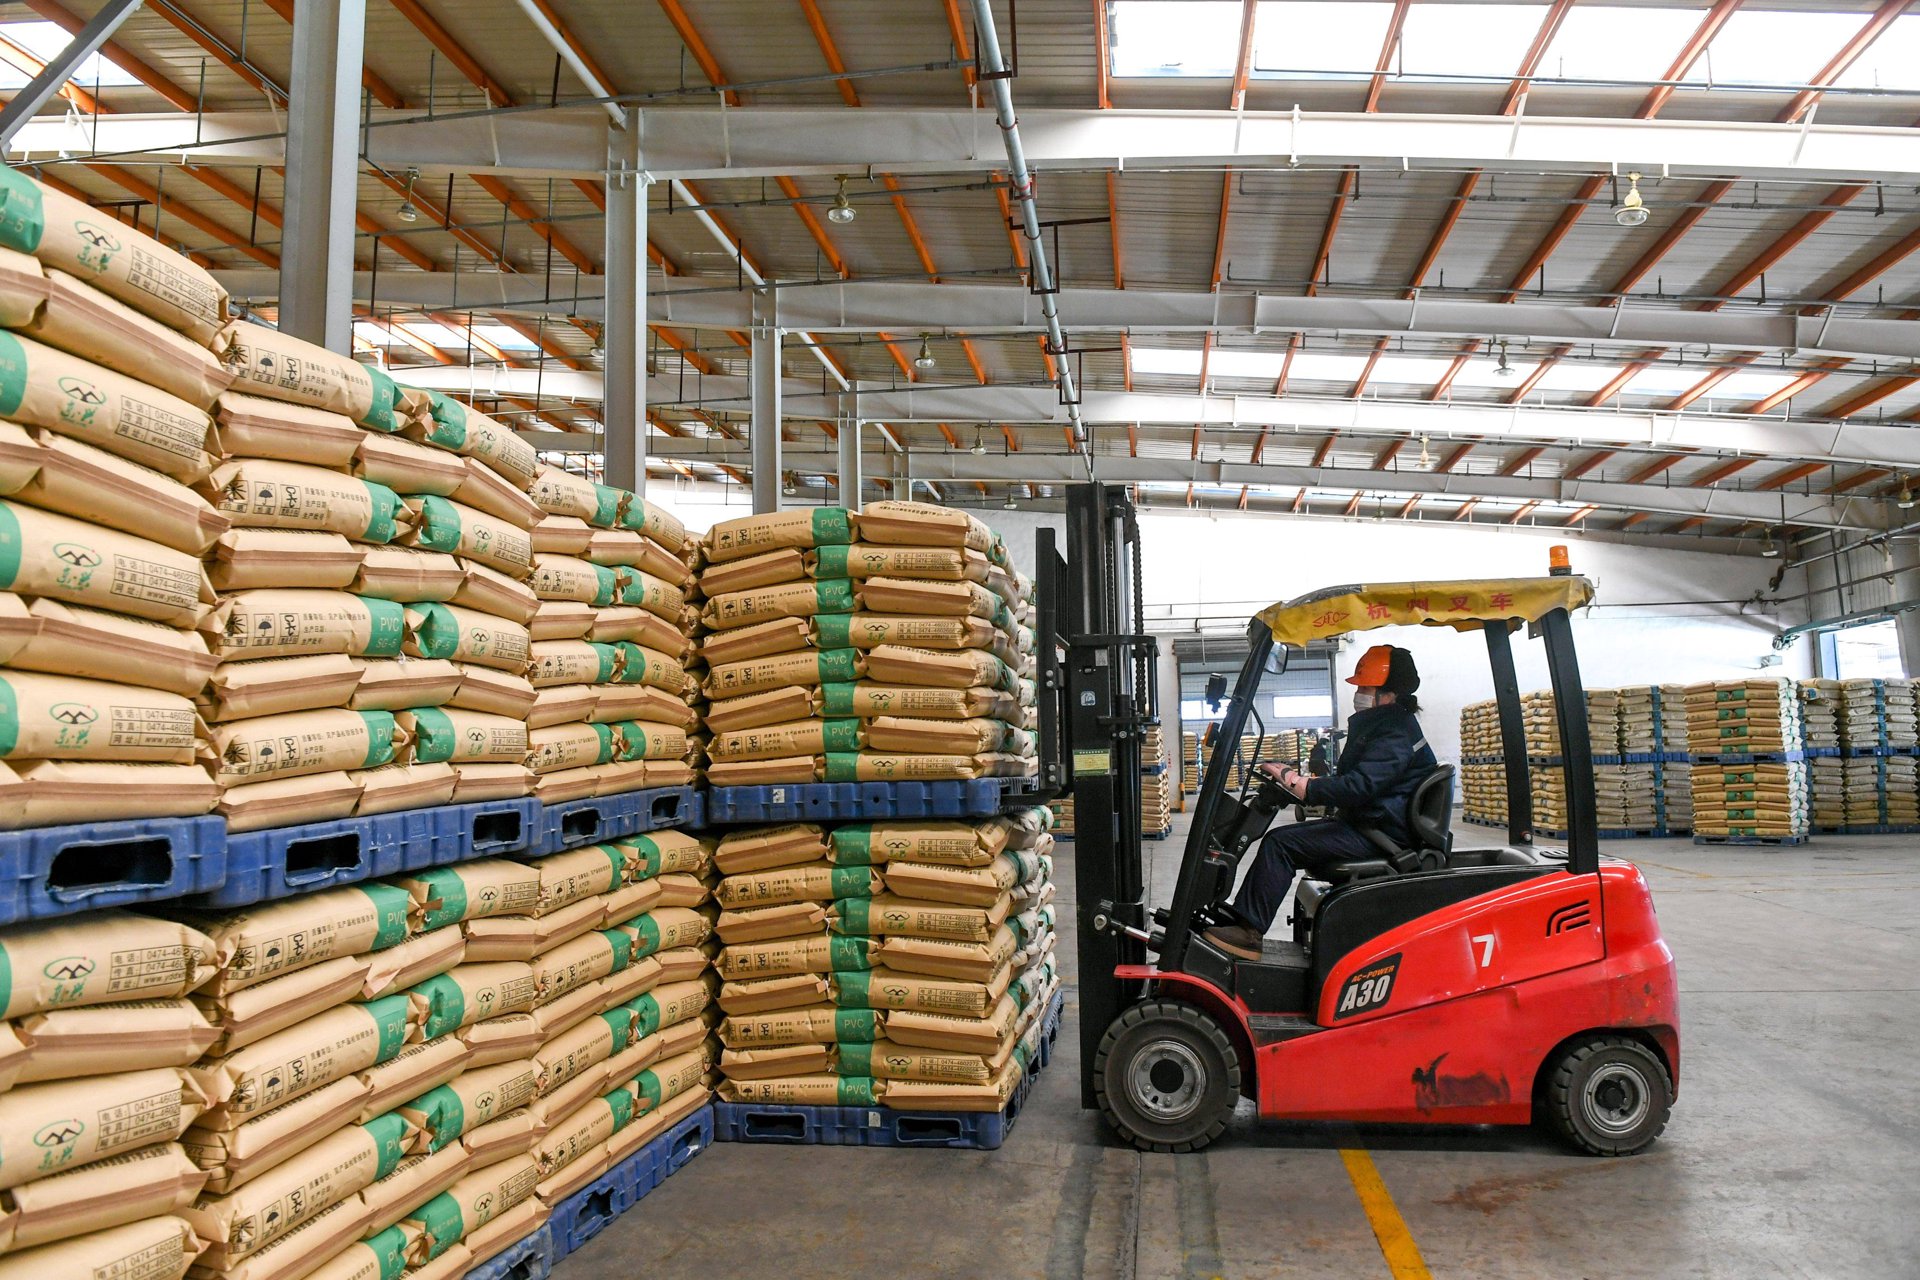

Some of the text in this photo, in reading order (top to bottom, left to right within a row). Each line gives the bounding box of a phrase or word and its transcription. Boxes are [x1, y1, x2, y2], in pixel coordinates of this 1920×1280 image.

[381, 388, 394, 406] PV
[380, 502, 393, 517] PV
[376, 523, 390, 535] SG
[821, 519, 841, 528] PVC
[825, 586, 845, 596] PVC
[1367, 593, 1514, 620] 杭州叉车
[380, 616, 400, 633] PVC
[826, 655, 847, 665] PVC
[831, 725, 852, 736] PVC
[112, 734, 138, 746] 网址：
[840, 874, 861, 884] PVC
[387, 910, 407, 928] PVC
[839, 946, 860, 957] PVC
[1472, 933, 1495, 967] 7
[113, 953, 140, 967] 电话：
[113, 966, 140, 978] 传真：
[1351, 965, 1395, 983] AC-POWER
[111, 978, 138, 991] 网址：
[1339, 975, 1391, 1013] A30
[387, 1019, 406, 1039] PVC
[844, 1018, 866, 1029] PVC
[846, 1084, 867, 1096] PVC
[101, 1108, 129, 1122] 电话：
[101, 1121, 129, 1136] 传真：
[439, 1127, 456, 1141] G-5
[386, 1137, 401, 1157] PV
